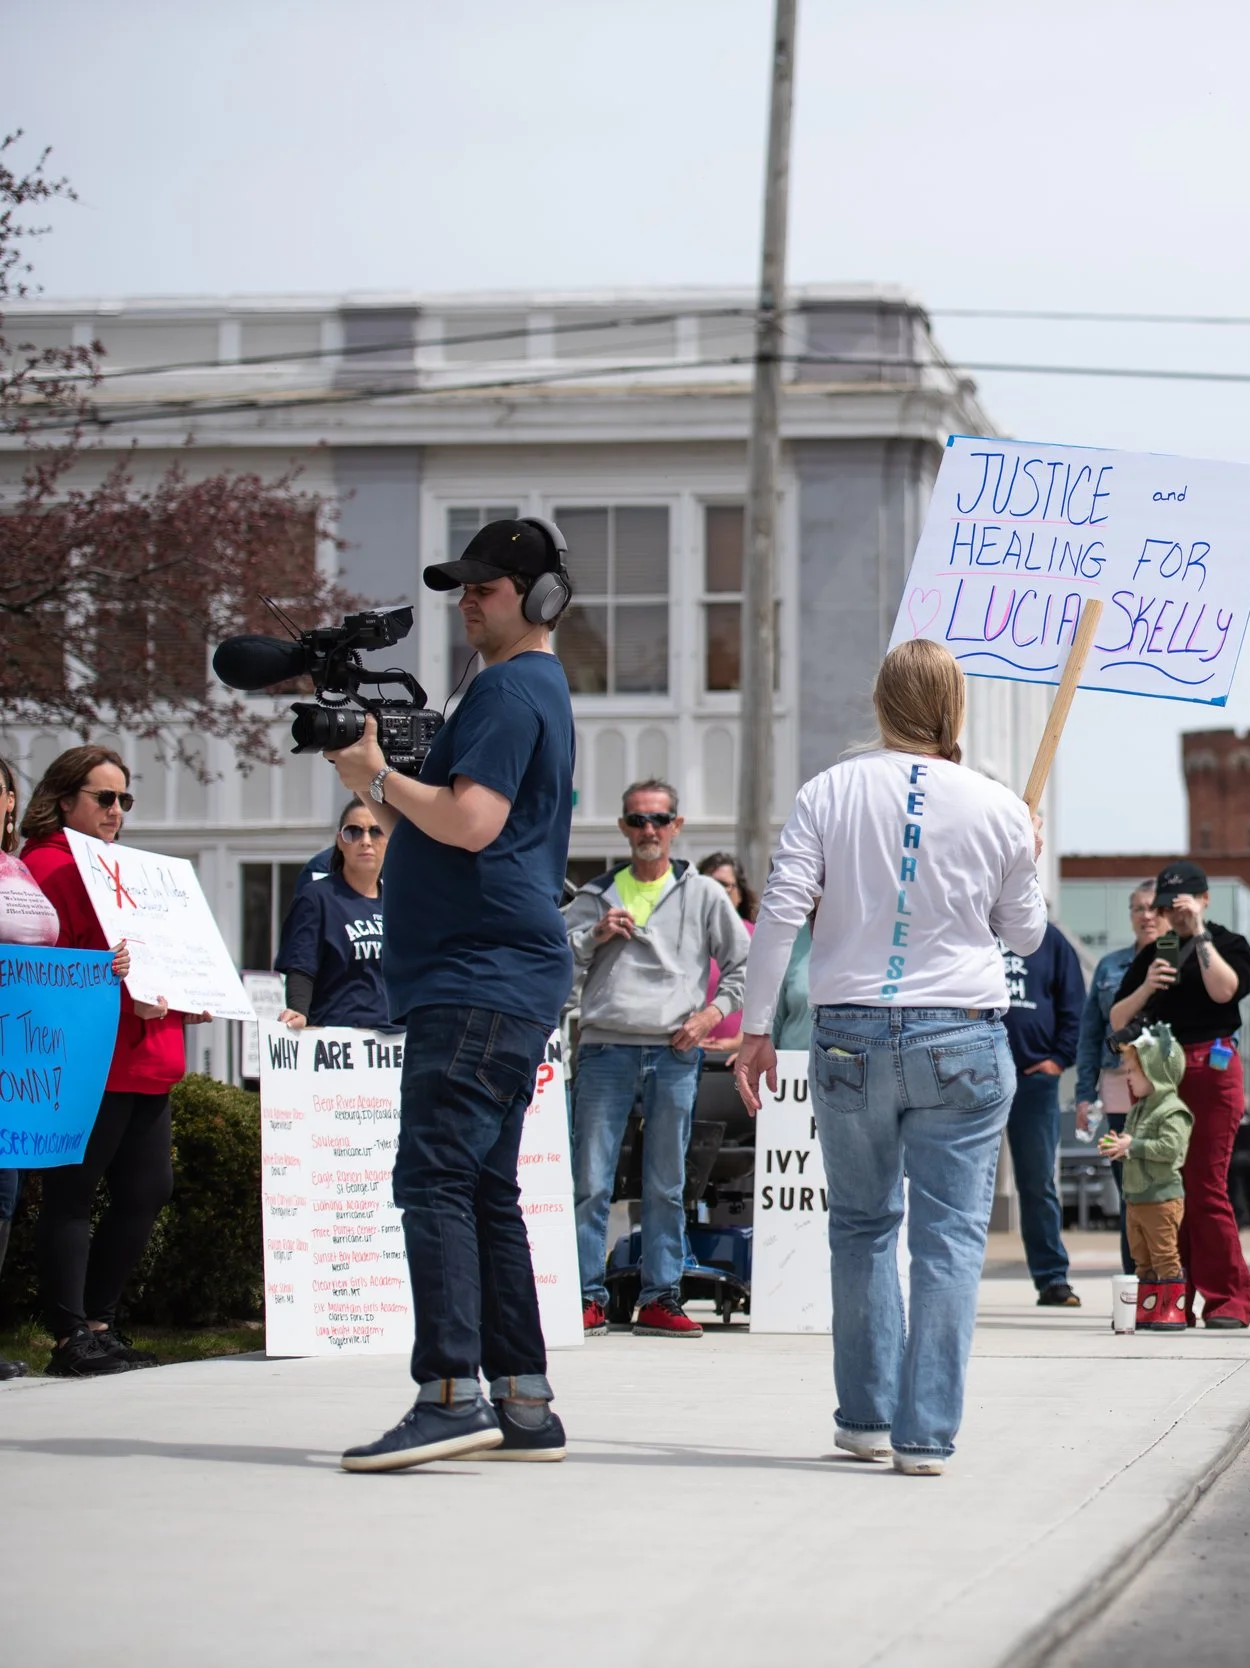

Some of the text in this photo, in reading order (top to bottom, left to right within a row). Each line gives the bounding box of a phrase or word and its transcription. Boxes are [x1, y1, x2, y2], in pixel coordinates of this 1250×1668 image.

[956, 452, 1188, 525] JUSTICE and
[949, 522, 1210, 592] HEALING FOR
[945, 578, 1234, 662] LUCIA SKELLY
[353, 941, 382, 960] IVY
[268, 1034, 299, 1071] WHY
[313, 1039, 354, 1072] ARE
[313, 1094, 392, 1112] Bear River Academy
[766, 1149, 810, 1174] IVY
[311, 1170, 334, 1189] Eagle
[346, 1199, 380, 1211] Academy
[521, 1203, 564, 1215] ilderness
[332, 1225, 355, 1236] Points
[356, 1225, 377, 1236] Center
[312, 1251, 337, 1265] Sunset
[338, 1250, 351, 1264] Bay
[312, 1278, 348, 1292] Clearview
[327, 1301, 362, 1314] Mountain
[362, 1303, 379, 1313] Girls
[379, 1301, 408, 1315] Academy
[352, 1325, 385, 1337] Academy
